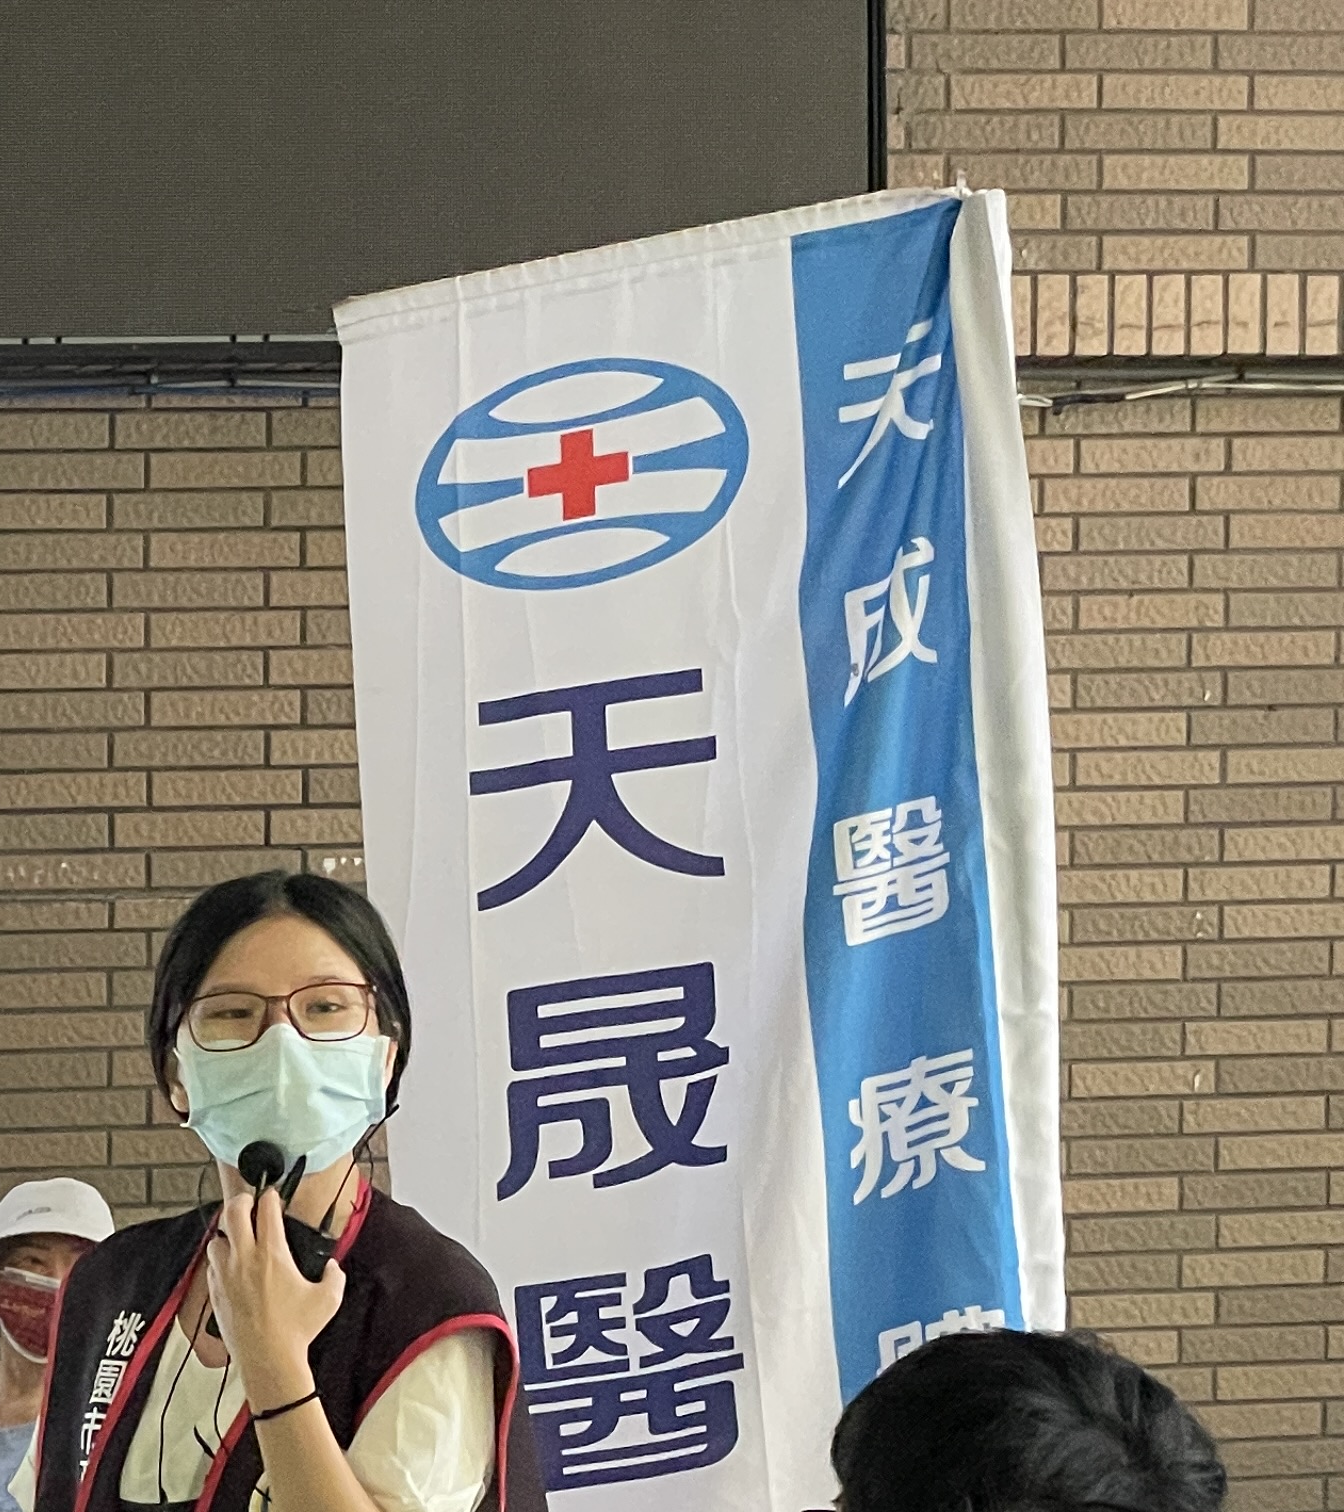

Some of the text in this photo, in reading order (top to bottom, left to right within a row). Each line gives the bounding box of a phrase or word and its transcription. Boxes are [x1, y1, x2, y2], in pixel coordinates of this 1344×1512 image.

[833, 320, 1005, 1376] 天成醫療
[80, 1310, 145, 1483] 桃園市
